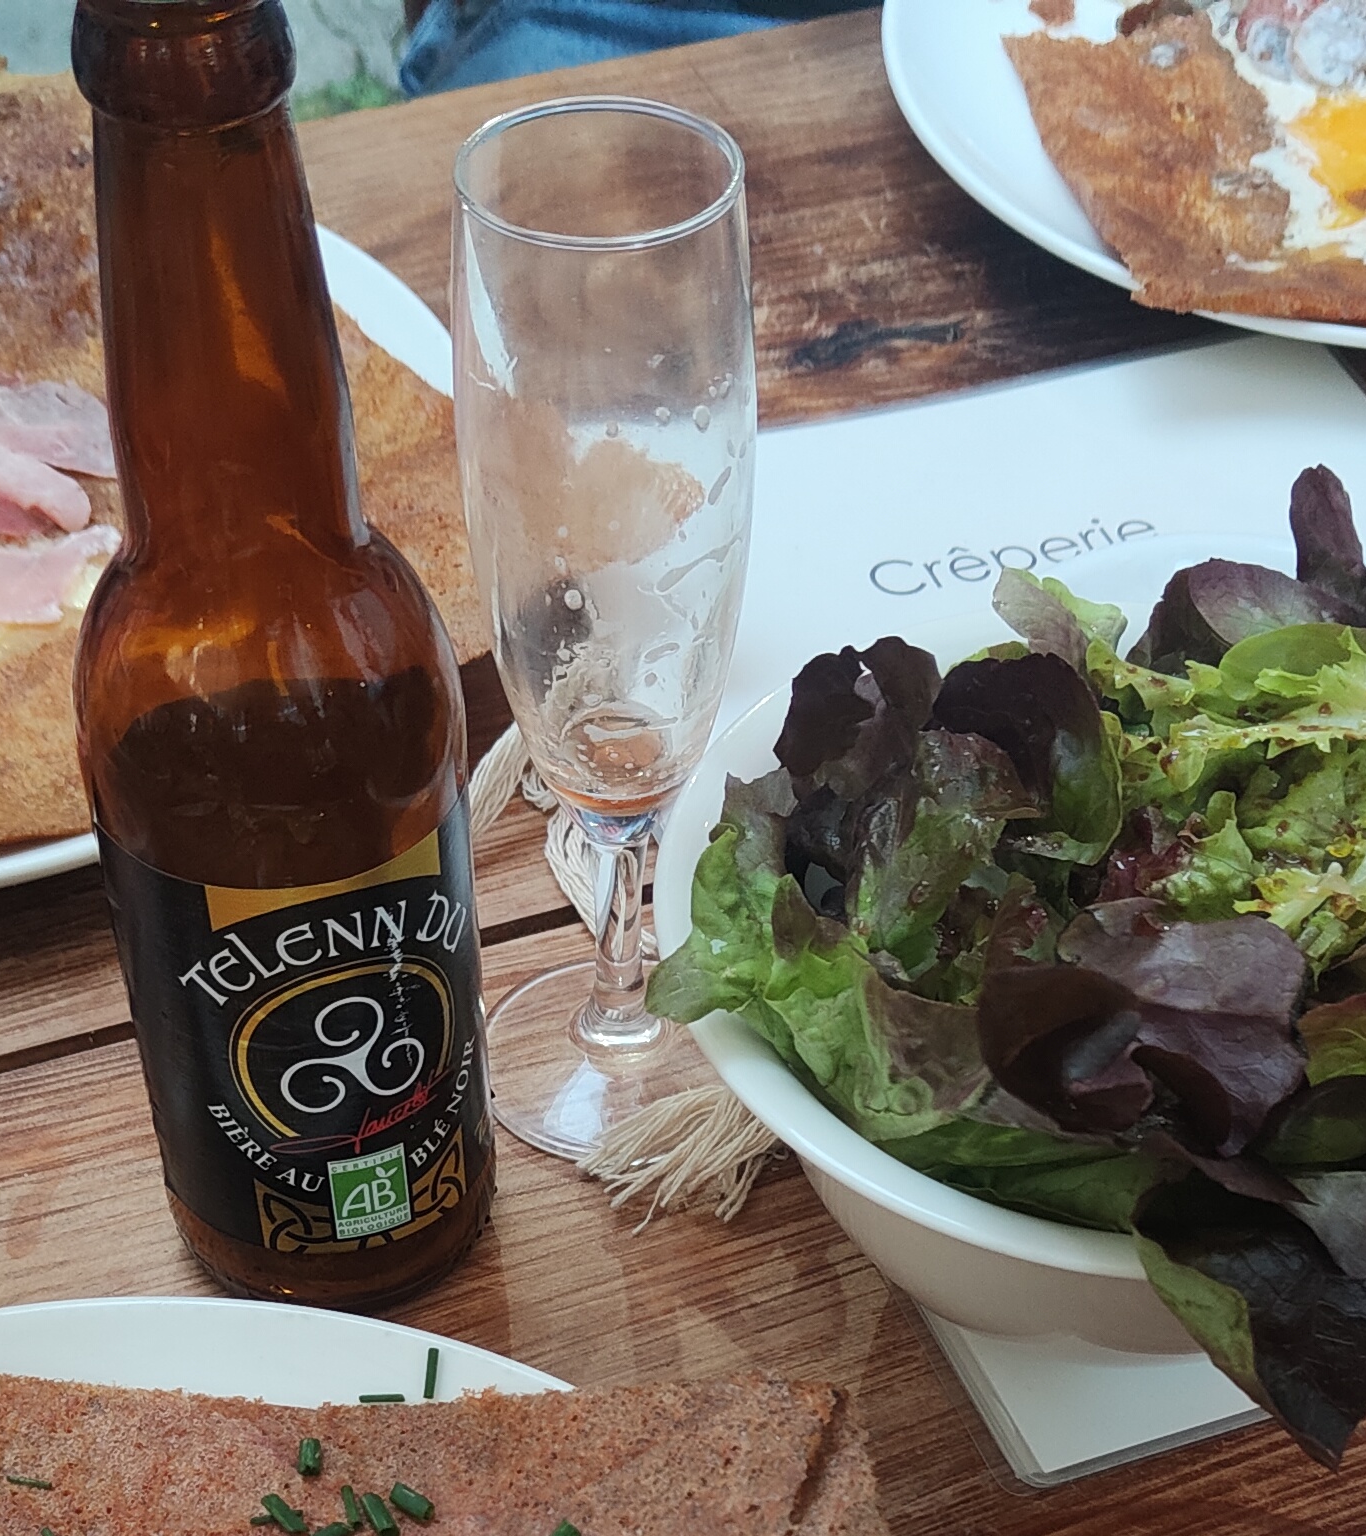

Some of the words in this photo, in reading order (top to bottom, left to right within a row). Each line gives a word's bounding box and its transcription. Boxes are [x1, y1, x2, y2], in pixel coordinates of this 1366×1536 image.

[207, 1103, 278, 1171] BIÈRE
[275, 1167, 326, 1192] AU
[408, 1118, 451, 1168] BLÉ
[445, 1034, 476, 1115] NOIR
[342, 1179, 396, 1217] AB
[338, 1205, 408, 1228] AGRICULTURE
[339, 1212, 409, 1235] BIOLOGIQUE
